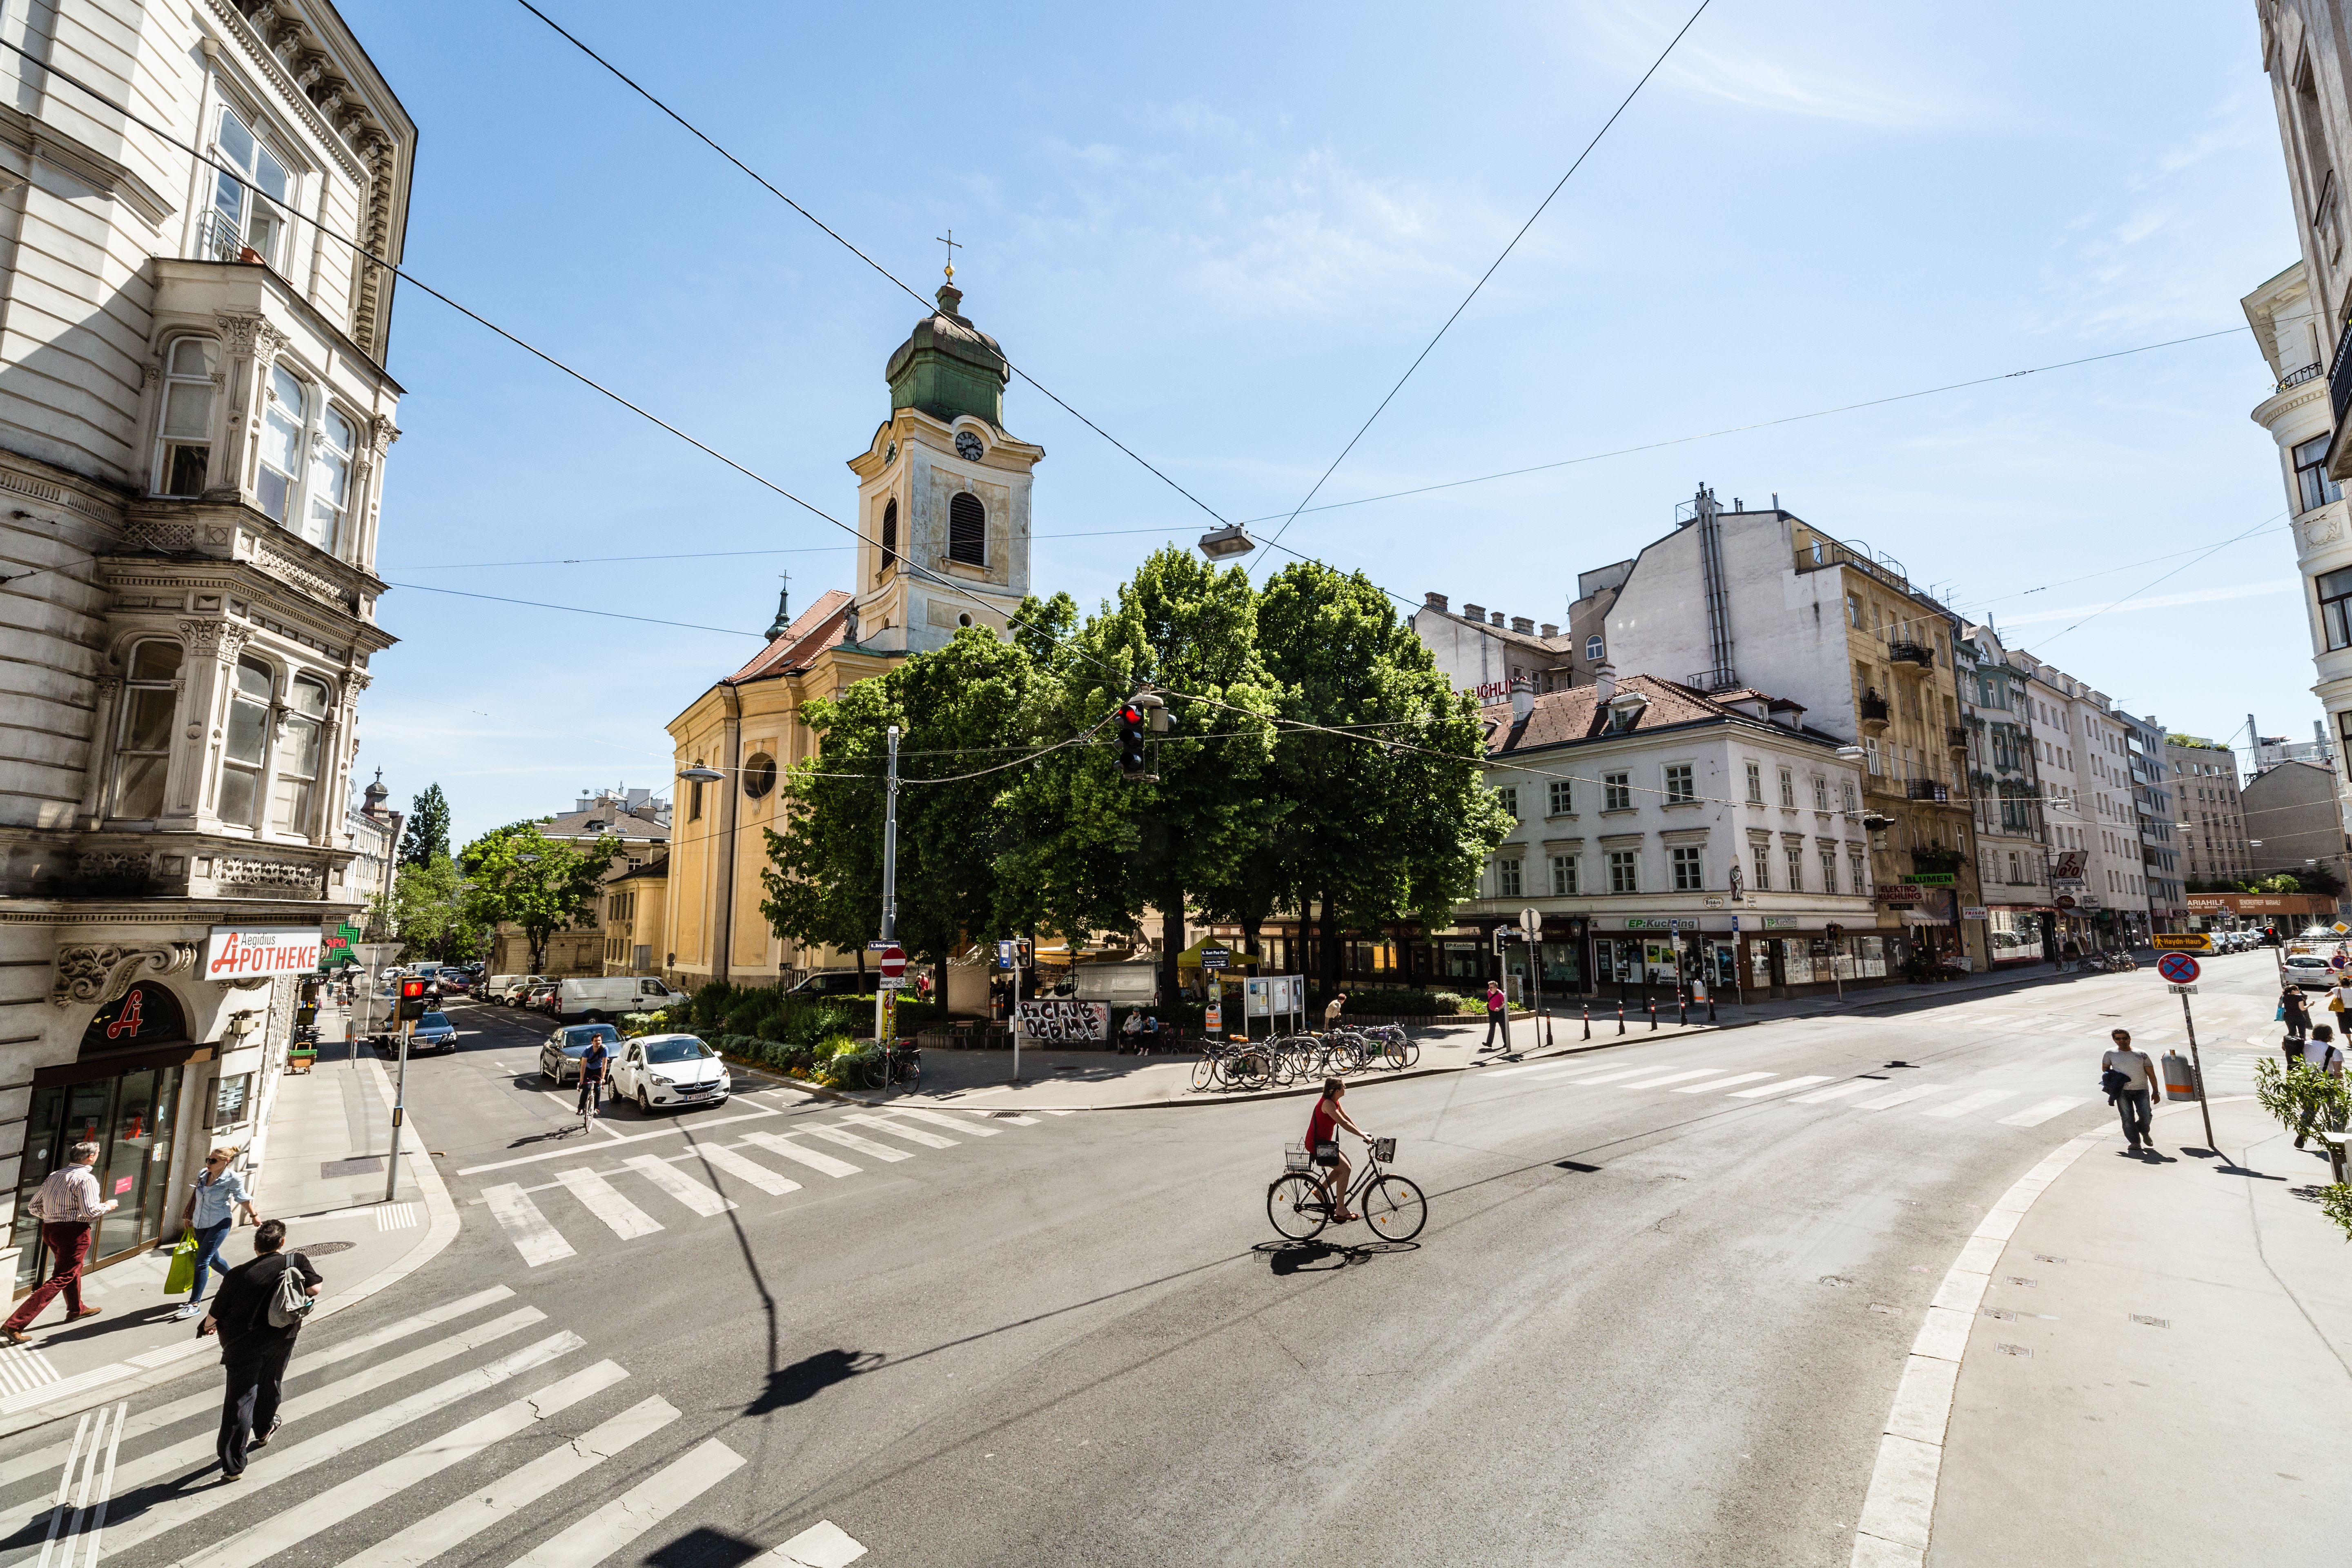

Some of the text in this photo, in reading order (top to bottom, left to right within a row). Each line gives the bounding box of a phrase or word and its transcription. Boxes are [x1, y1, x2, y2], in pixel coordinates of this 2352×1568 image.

[1904, 875, 1952, 883] BLUMEN
[1628, 919, 1695, 929] EP:Kuching
[1767, 919, 1797, 928] EP:Kuchling
[241, 932, 276, 949] Aegidius
